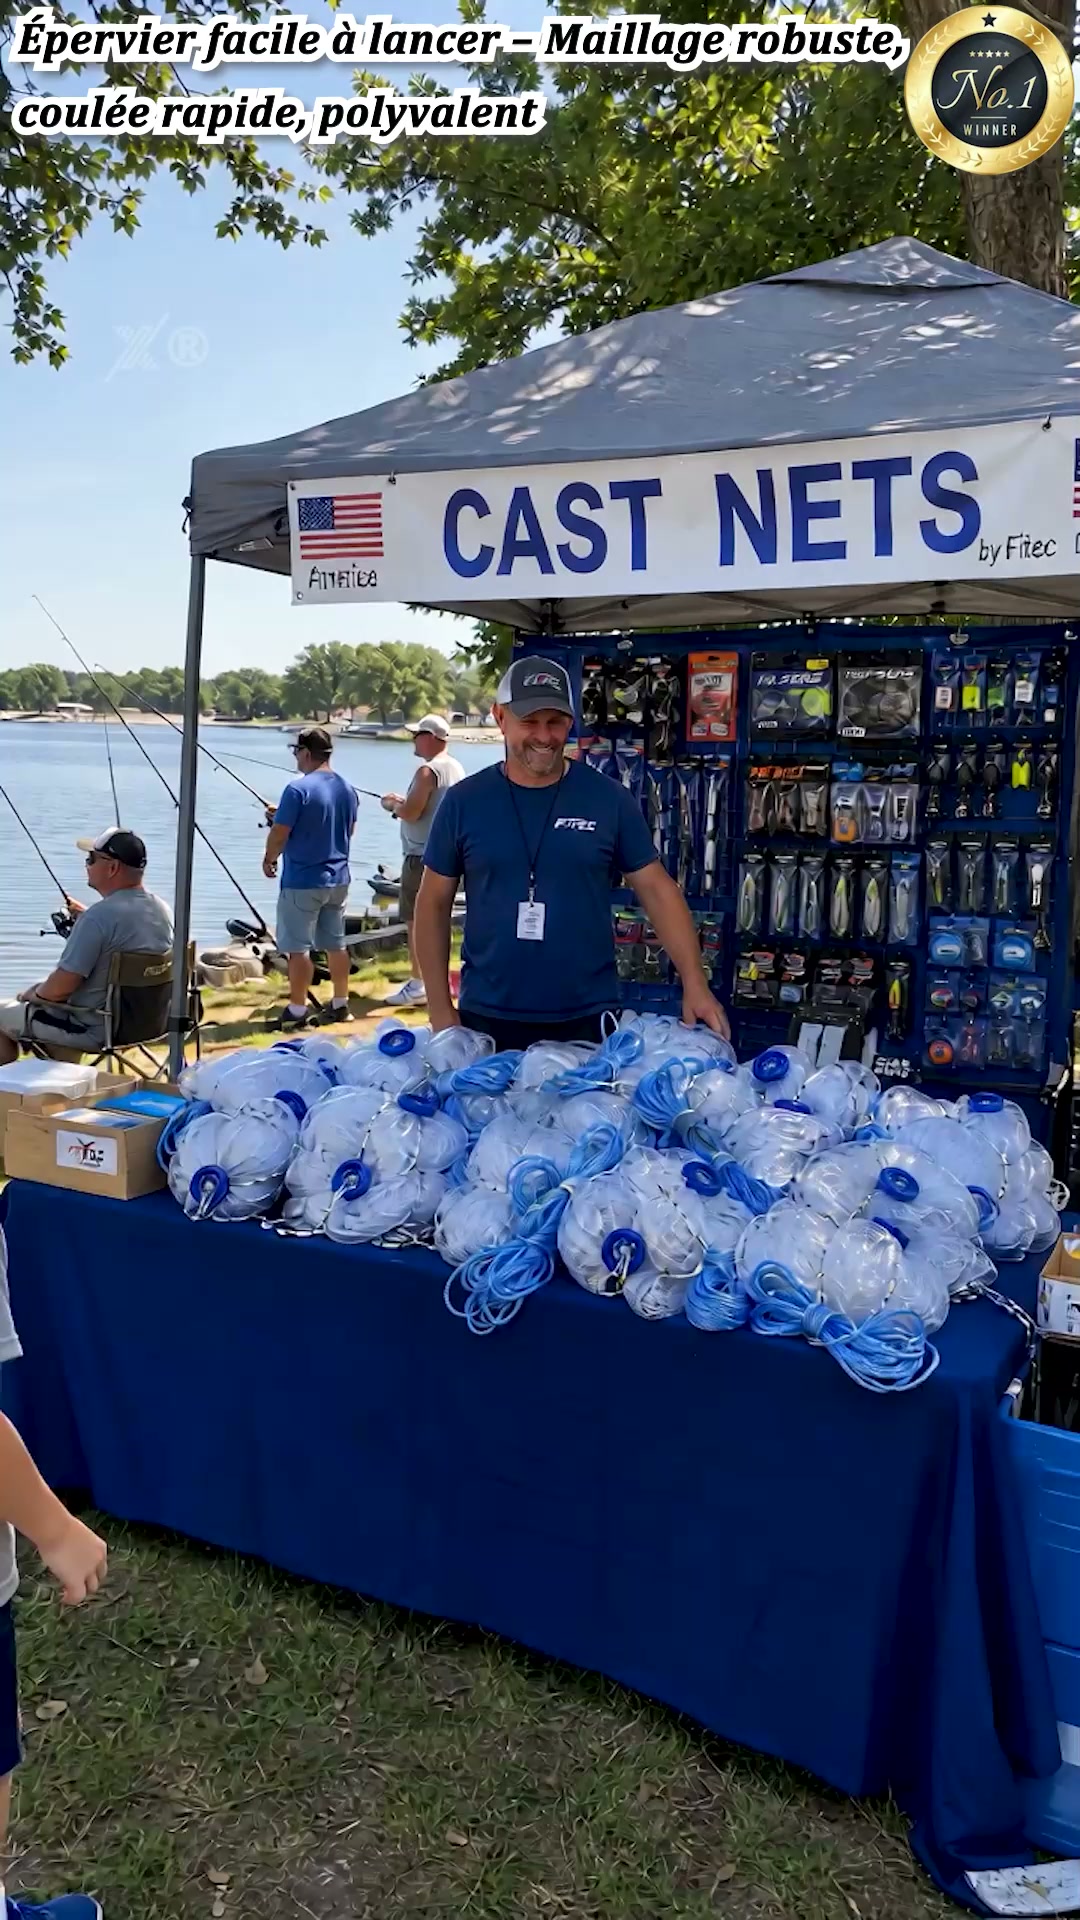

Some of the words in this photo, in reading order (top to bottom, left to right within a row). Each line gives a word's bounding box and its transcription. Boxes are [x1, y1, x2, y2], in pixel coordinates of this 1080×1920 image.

[443, 478, 662, 577] CAST
[715, 450, 982, 568] NETS
[979, 538, 1001, 567] by
